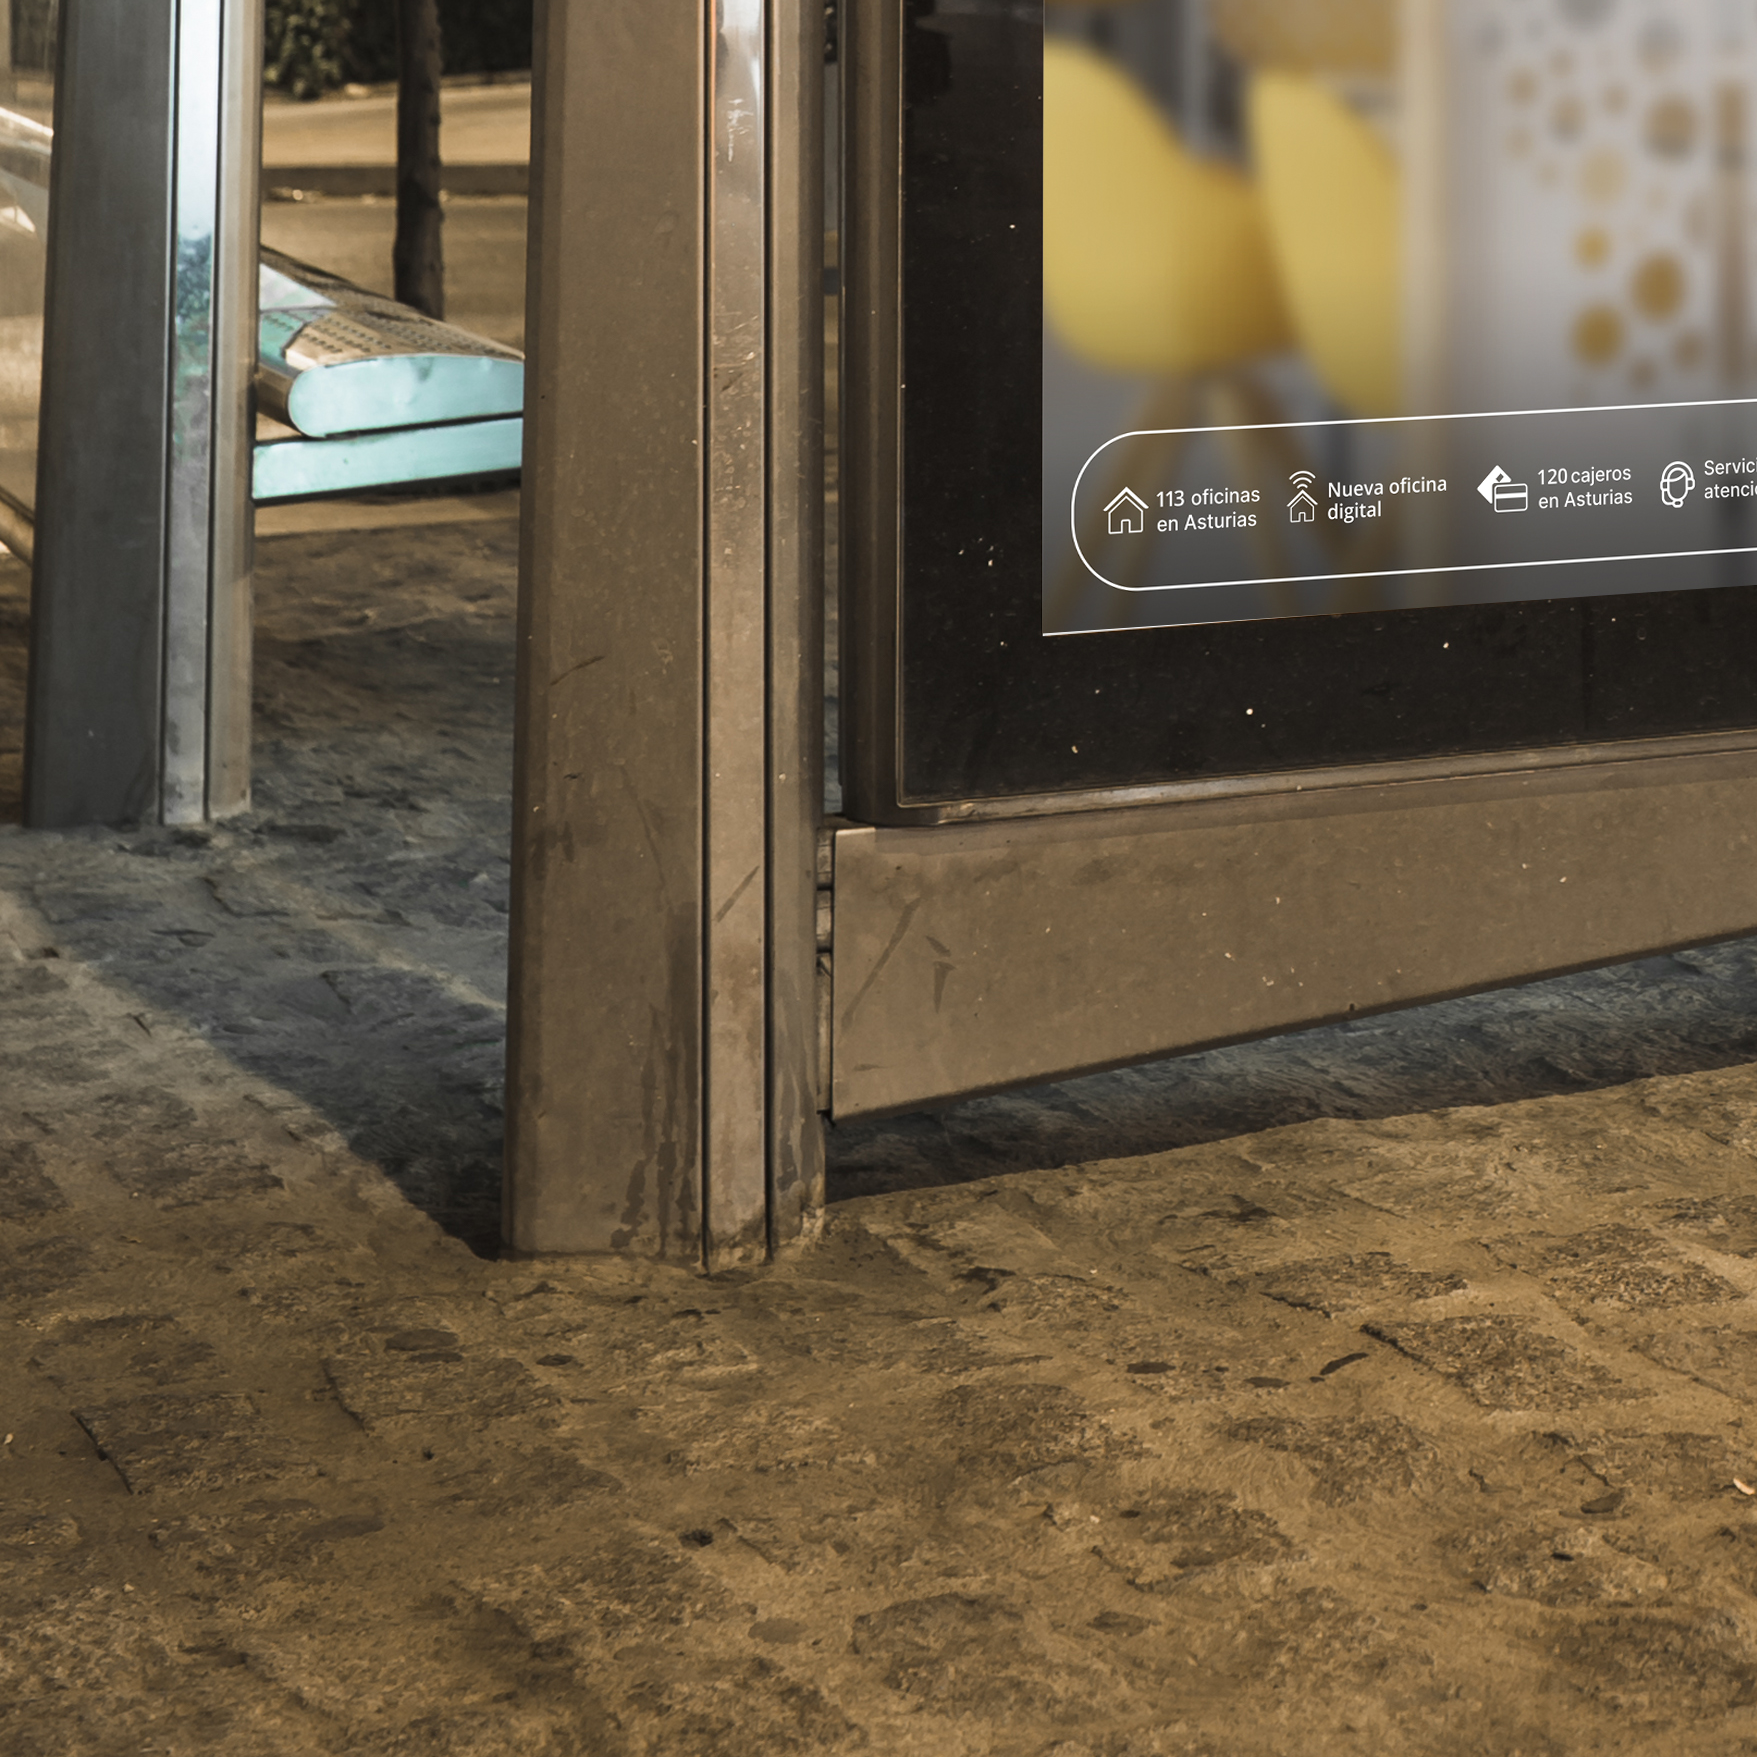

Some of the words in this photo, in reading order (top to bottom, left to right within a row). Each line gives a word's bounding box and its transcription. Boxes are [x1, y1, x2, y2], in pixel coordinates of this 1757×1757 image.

[1328, 481, 1384, 498] Nueva
[1389, 476, 1447, 495] oficina
[1537, 467, 1568, 485] 120
[1570, 466, 1632, 487] cajeros
[1156, 489, 1185, 508] 113
[1191, 487, 1260, 506] oficinas
[1538, 496, 1559, 509] en
[1564, 488, 1633, 508] Asturias
[1157, 518, 1179, 532] en
[1184, 511, 1257, 531] Asturias
[1327, 500, 1382, 524] digital
